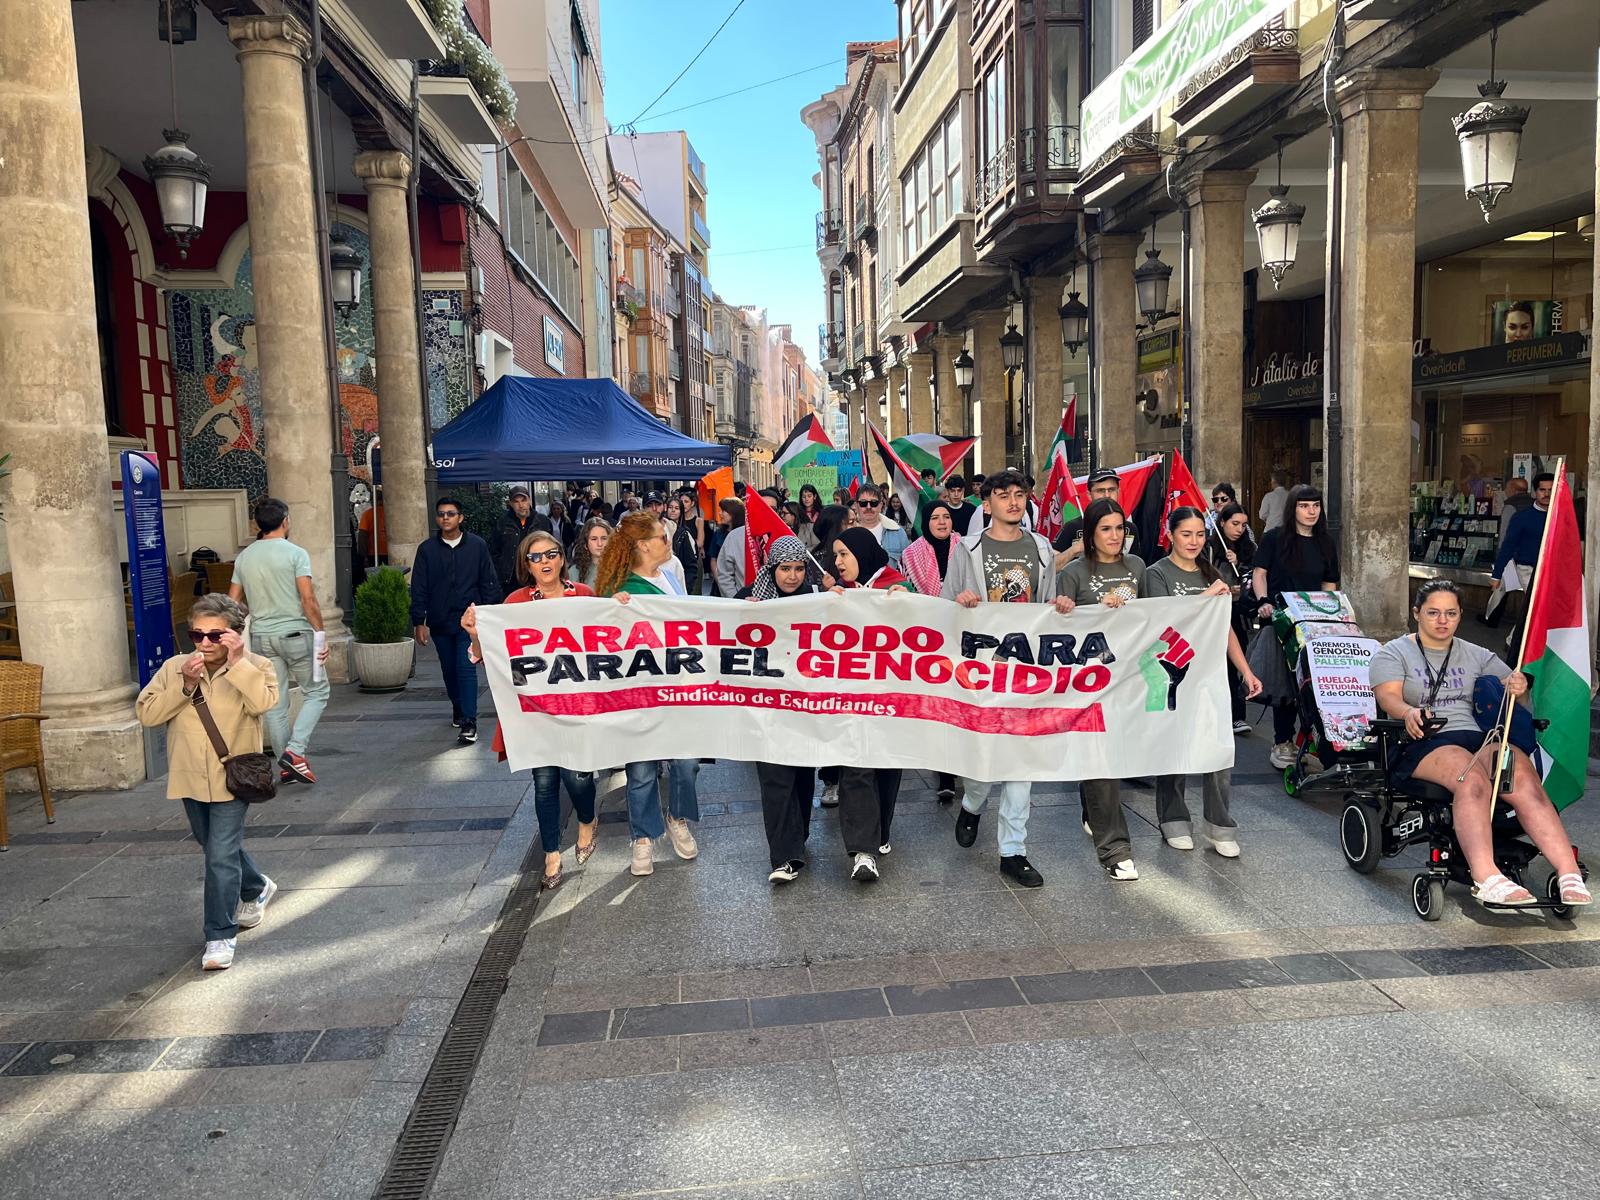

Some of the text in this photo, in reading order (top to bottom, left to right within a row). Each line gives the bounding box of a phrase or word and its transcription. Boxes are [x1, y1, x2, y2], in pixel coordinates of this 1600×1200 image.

[1124, 0, 1252, 110] NUEVA PROMOC
[1302, 352, 1319, 377] de
[435, 456, 714, 468] sol Luz Gas Movilidad Solar
[504, 620, 1116, 665] PARARLO TODO PARA
[1313, 647, 1371, 657] GENOCIDIO
[510, 647, 1111, 694] PARAR EL GENOCIDIO
[1315, 658, 1370, 667] PALESTINO
[1318, 676, 1358, 684] HUELGA
[657, 687, 897, 717] Sindicato de Estudiantes
